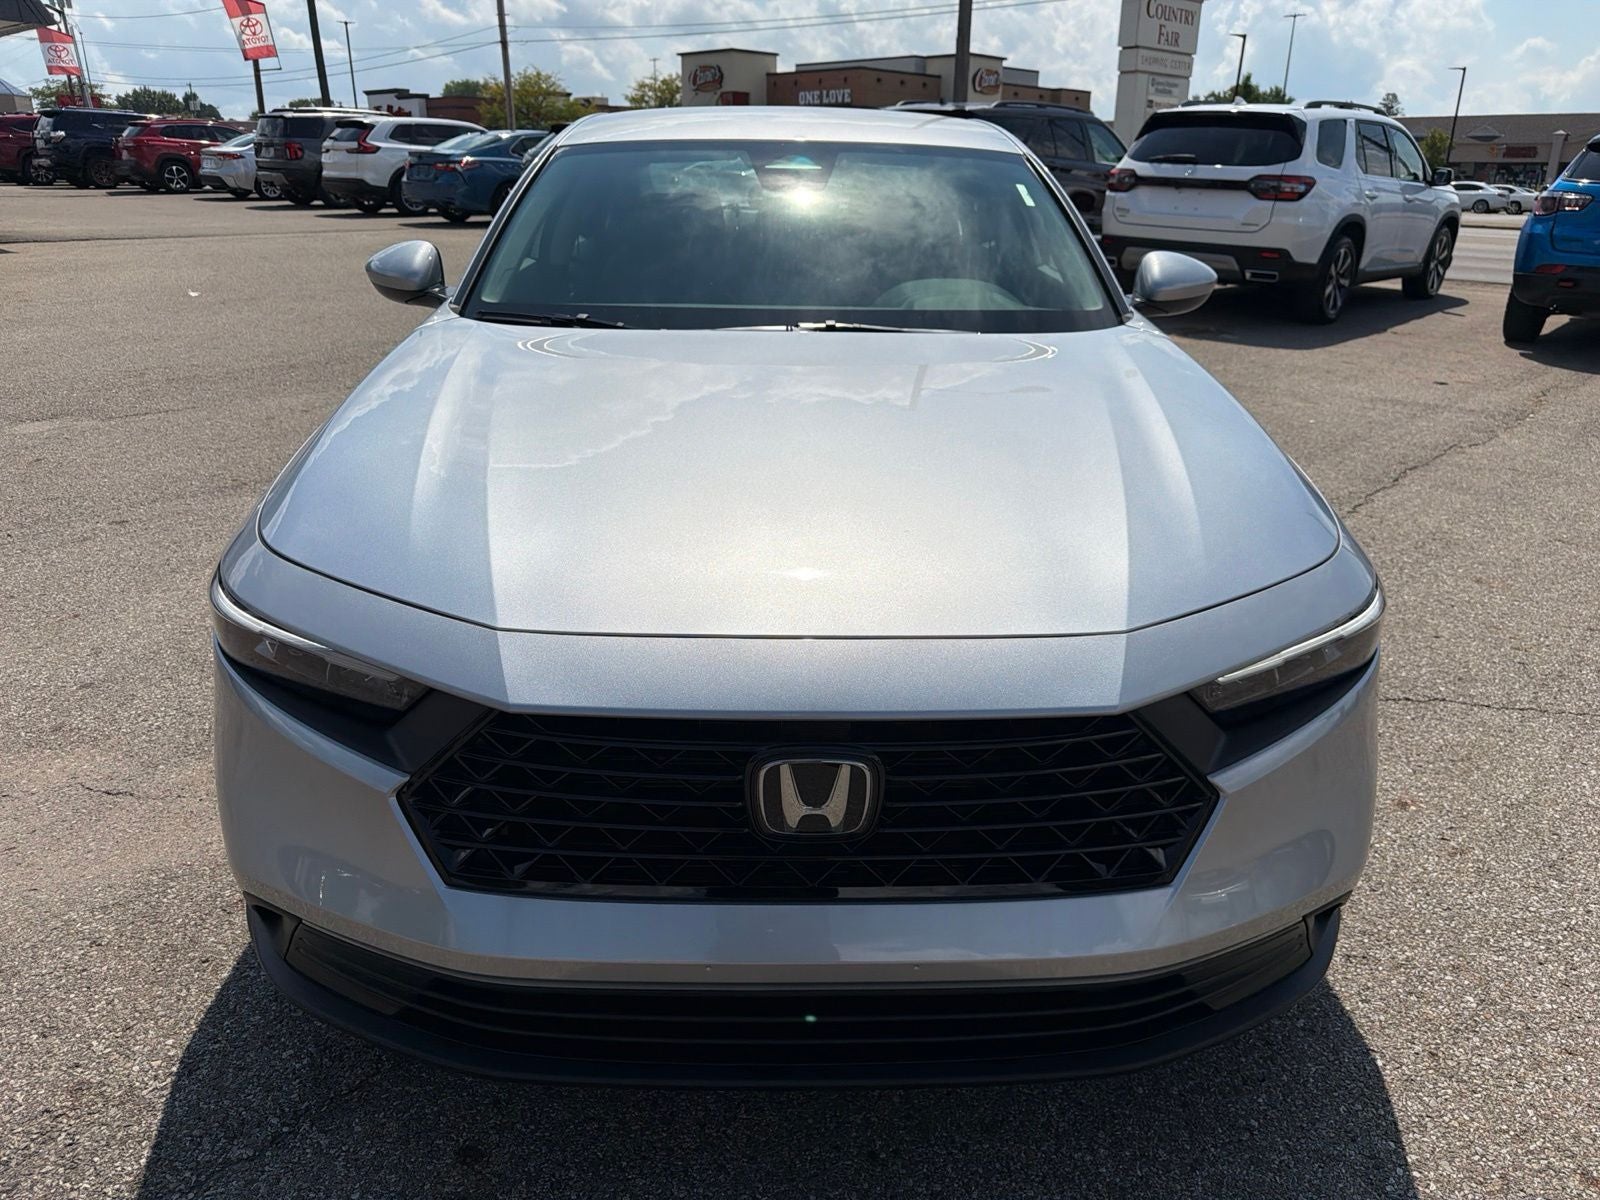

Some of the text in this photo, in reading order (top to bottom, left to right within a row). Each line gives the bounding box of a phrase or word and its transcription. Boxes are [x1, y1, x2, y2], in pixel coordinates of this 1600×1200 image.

[1146, 0, 1196, 26] COUNTRY
[1157, 24, 1181, 48] FAIR
[799, 88, 851, 105] ONE LOVE
